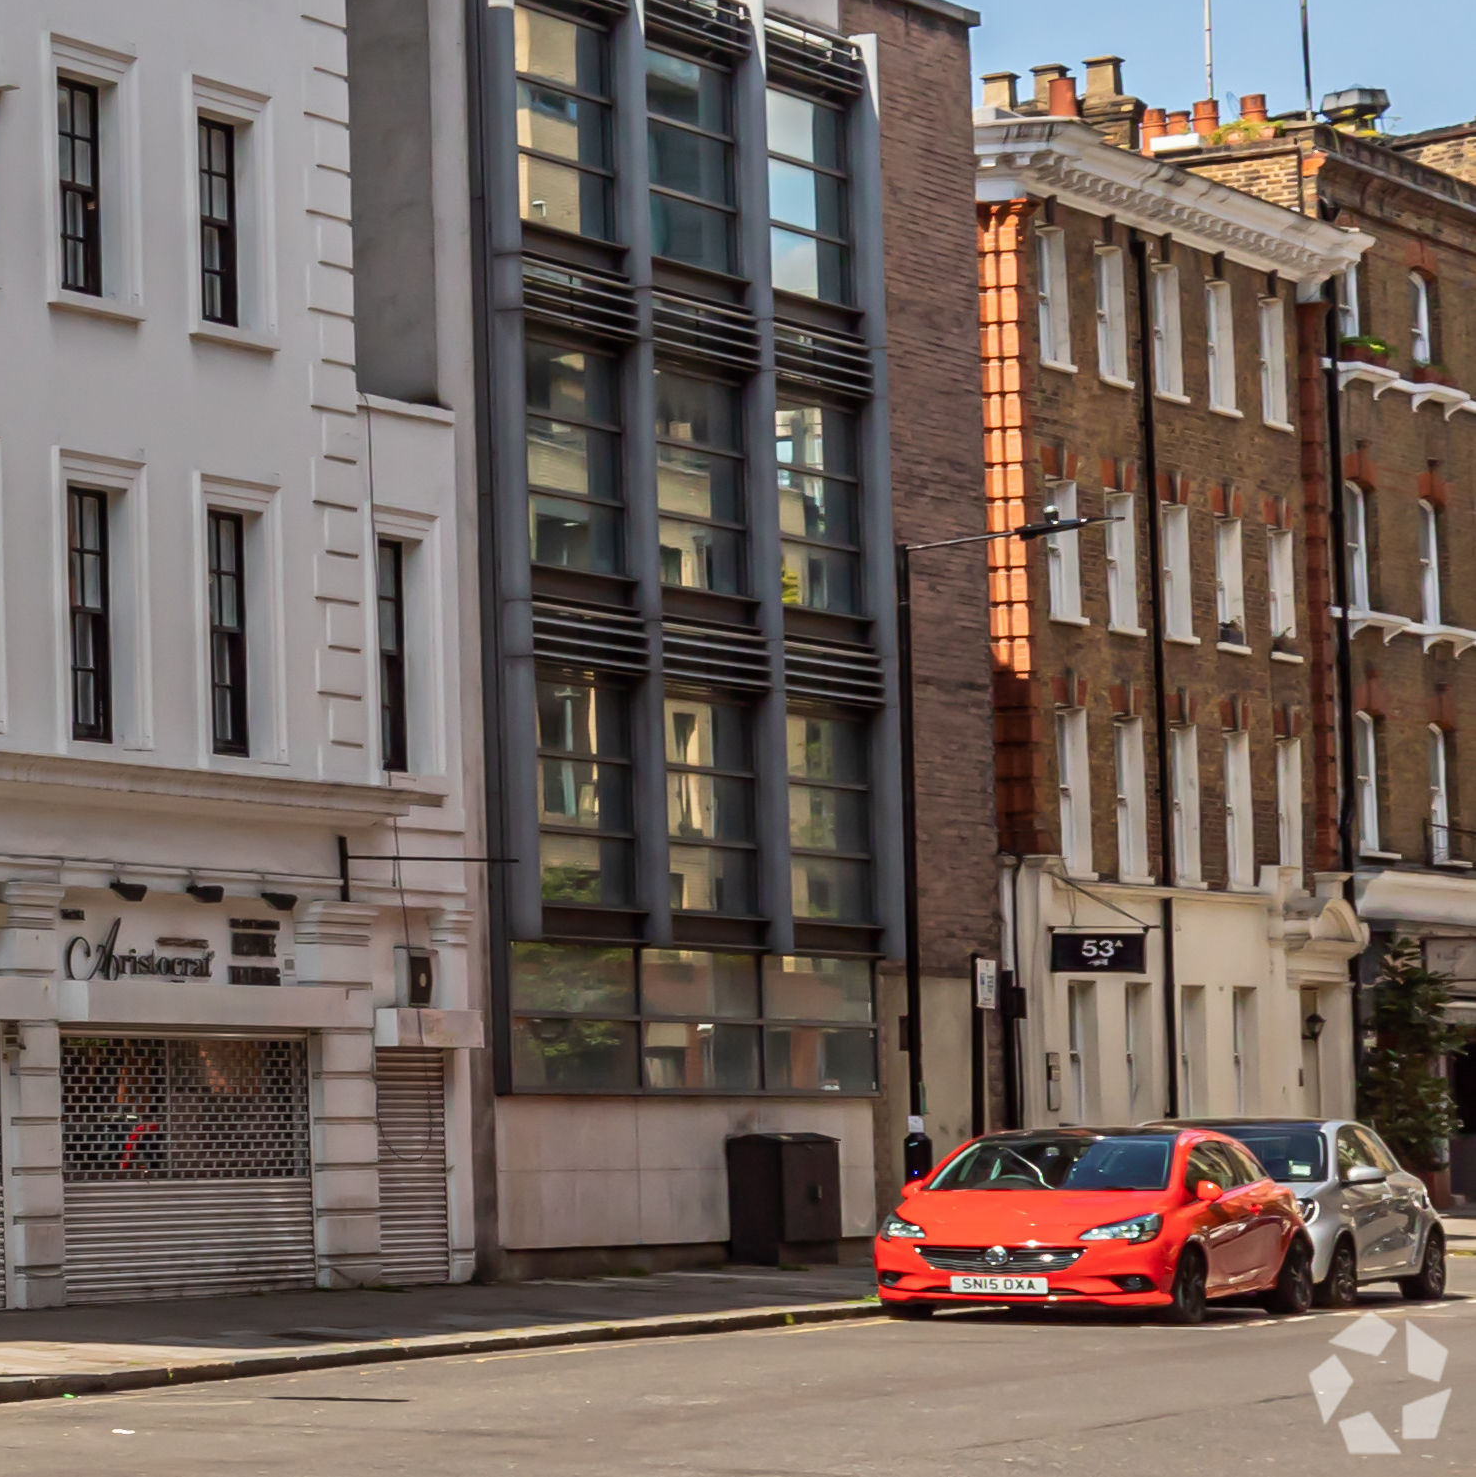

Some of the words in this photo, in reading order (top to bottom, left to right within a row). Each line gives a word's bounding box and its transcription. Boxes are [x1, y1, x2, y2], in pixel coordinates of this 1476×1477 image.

[66, 916, 215, 981] Aristocrat
[962, 1278, 998, 1290] SN15
[1003, 1278, 1036, 1291] OXA
